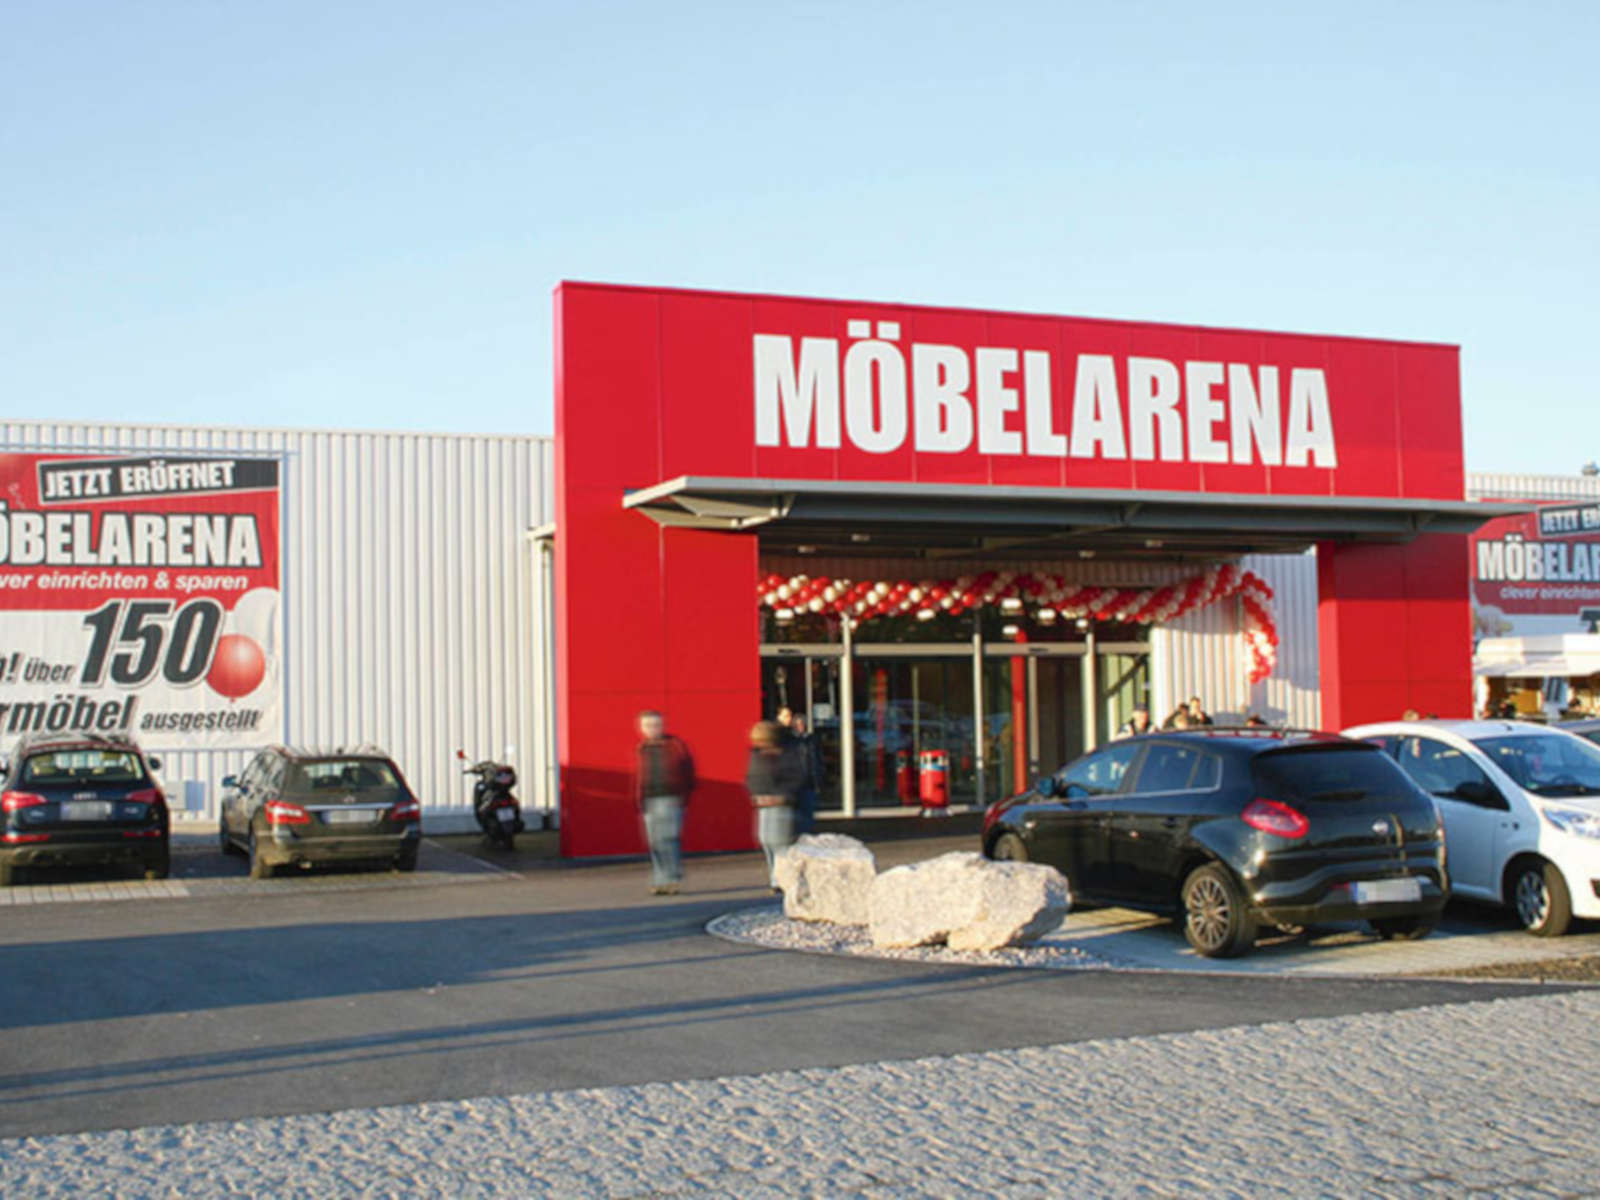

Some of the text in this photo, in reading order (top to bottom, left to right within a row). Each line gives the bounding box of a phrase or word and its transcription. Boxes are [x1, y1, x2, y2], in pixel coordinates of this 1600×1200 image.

[753, 320, 1338, 469] MÖBELARENA
[45, 460, 236, 498] JETZT ERÖFFNET
[38, 571, 148, 590] einrichten
[154, 573, 170, 590] &
[175, 573, 249, 593] sparen
[82, 600, 223, 685] 150
[140, 709, 260, 731] ausgestellt
